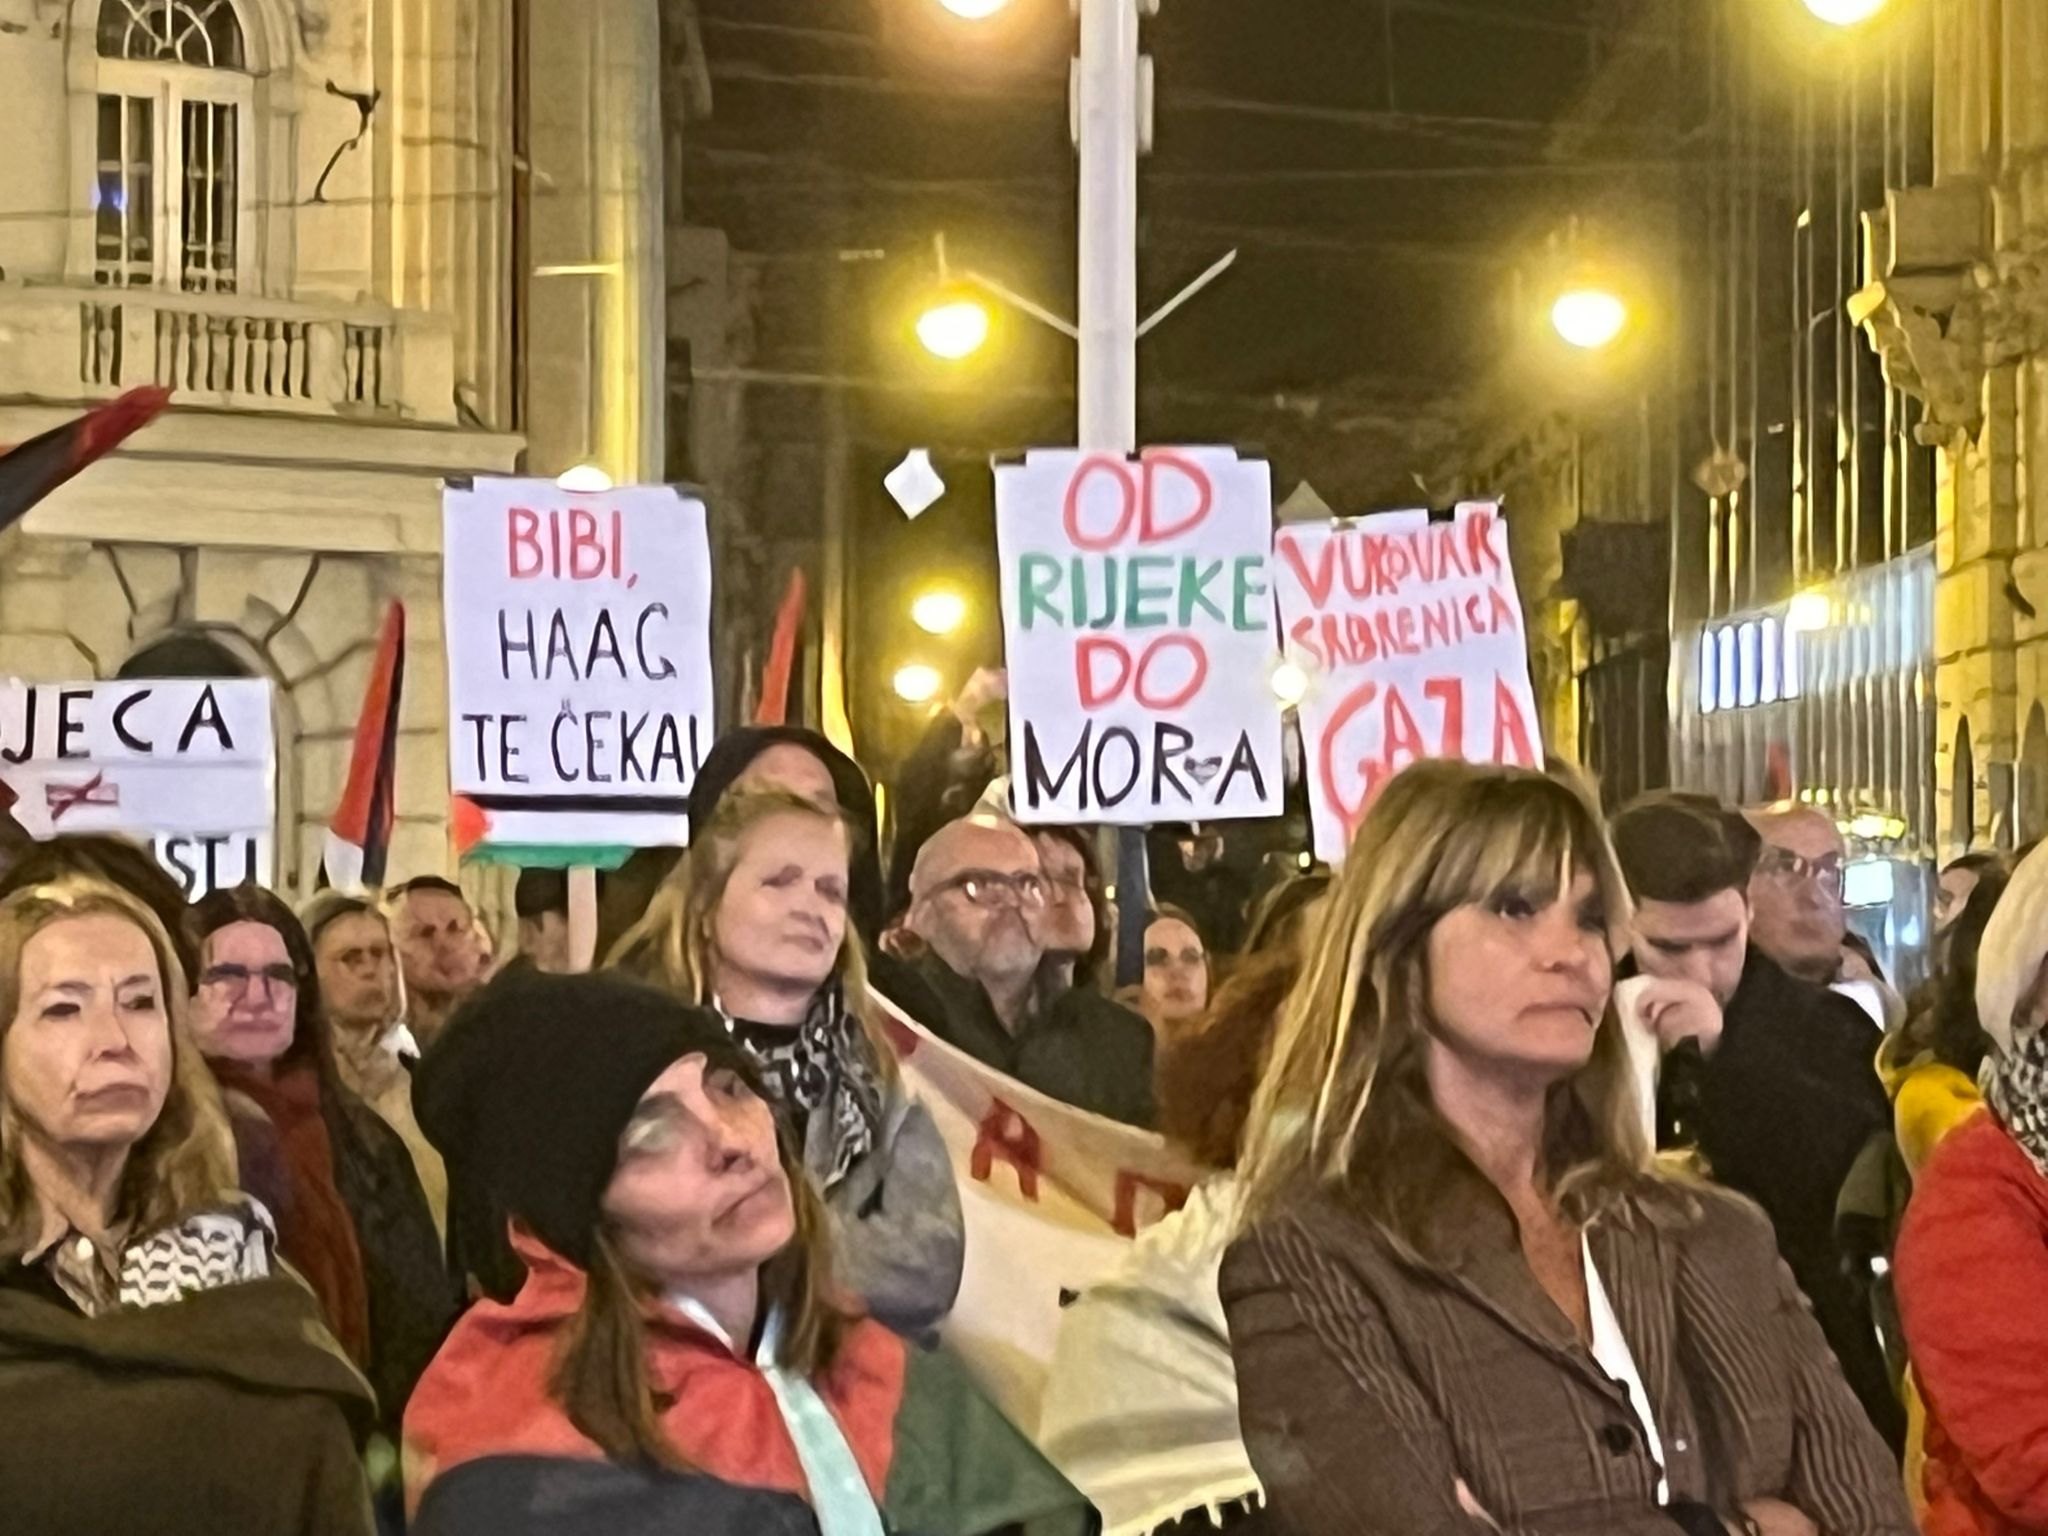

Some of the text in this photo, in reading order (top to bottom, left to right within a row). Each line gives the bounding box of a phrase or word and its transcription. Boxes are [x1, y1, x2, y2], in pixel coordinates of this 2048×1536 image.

[1063, 453, 1213, 552] OD
[508, 507, 639, 588] BIBI,
[1018, 552, 1268, 631] RIJEKE
[497, 602, 677, 681] HAAG
[1075, 634, 1209, 712] DO
[0, 684, 235, 763] JECA
[462, 713, 529, 783] TE
[1023, 718, 1267, 812] MORA
